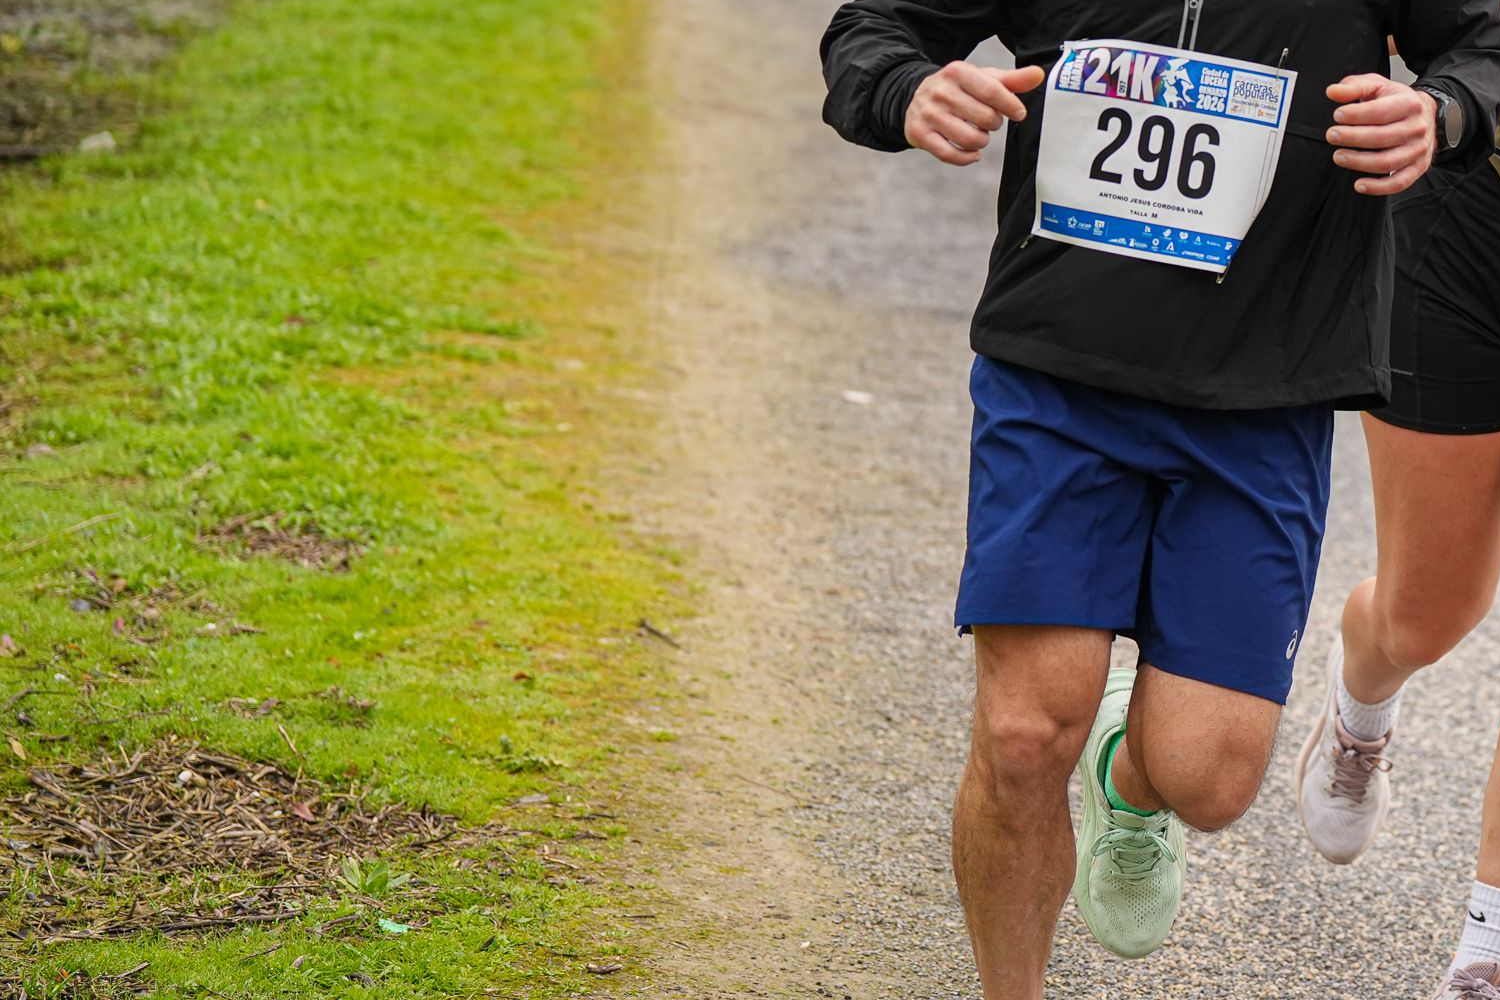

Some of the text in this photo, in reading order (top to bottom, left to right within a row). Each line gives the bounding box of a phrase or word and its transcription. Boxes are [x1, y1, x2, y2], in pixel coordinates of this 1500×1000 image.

[1083, 47, 1160, 102] 21K
[1233, 87, 1279, 104] populares
[1234, 80, 1273, 94] carreras
[1196, 94, 1225, 113] 2026
[1089, 107, 1220, 200] 296
[1099, 192, 1203, 216] ANTONIO JESUS CORDOBA VIDA
